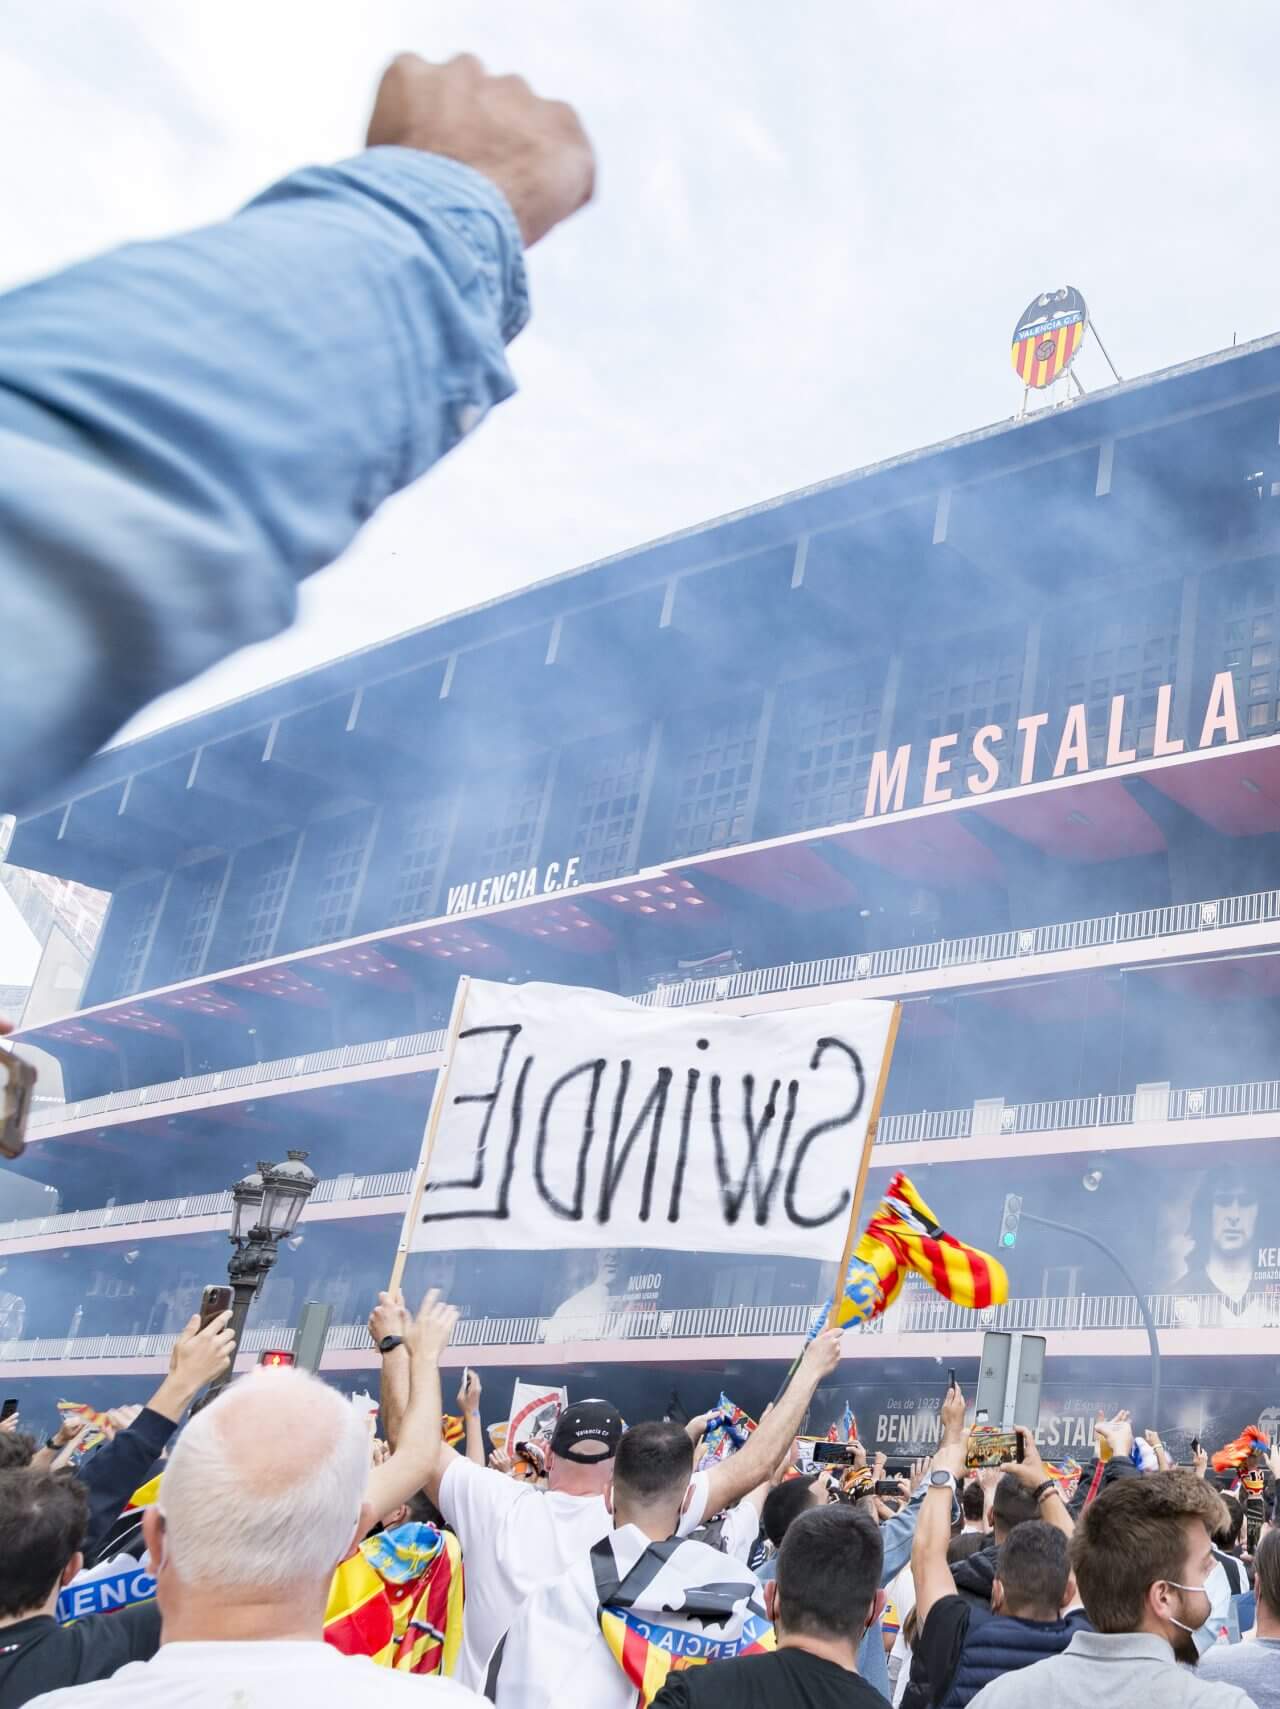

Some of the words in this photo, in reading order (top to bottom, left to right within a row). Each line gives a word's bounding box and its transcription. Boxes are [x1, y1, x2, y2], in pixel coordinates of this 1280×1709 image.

[1018, 319, 1063, 339] VALENCIA
[864, 671, 1240, 818] MESTALLA
[446, 867, 538, 915] VALENCIA
[543, 857, 580, 893] C.F.
[918, 1398, 941, 1409] 1923
[575, 1428, 601, 1438] Valencia
[876, 1415, 945, 1443] BENVIN
